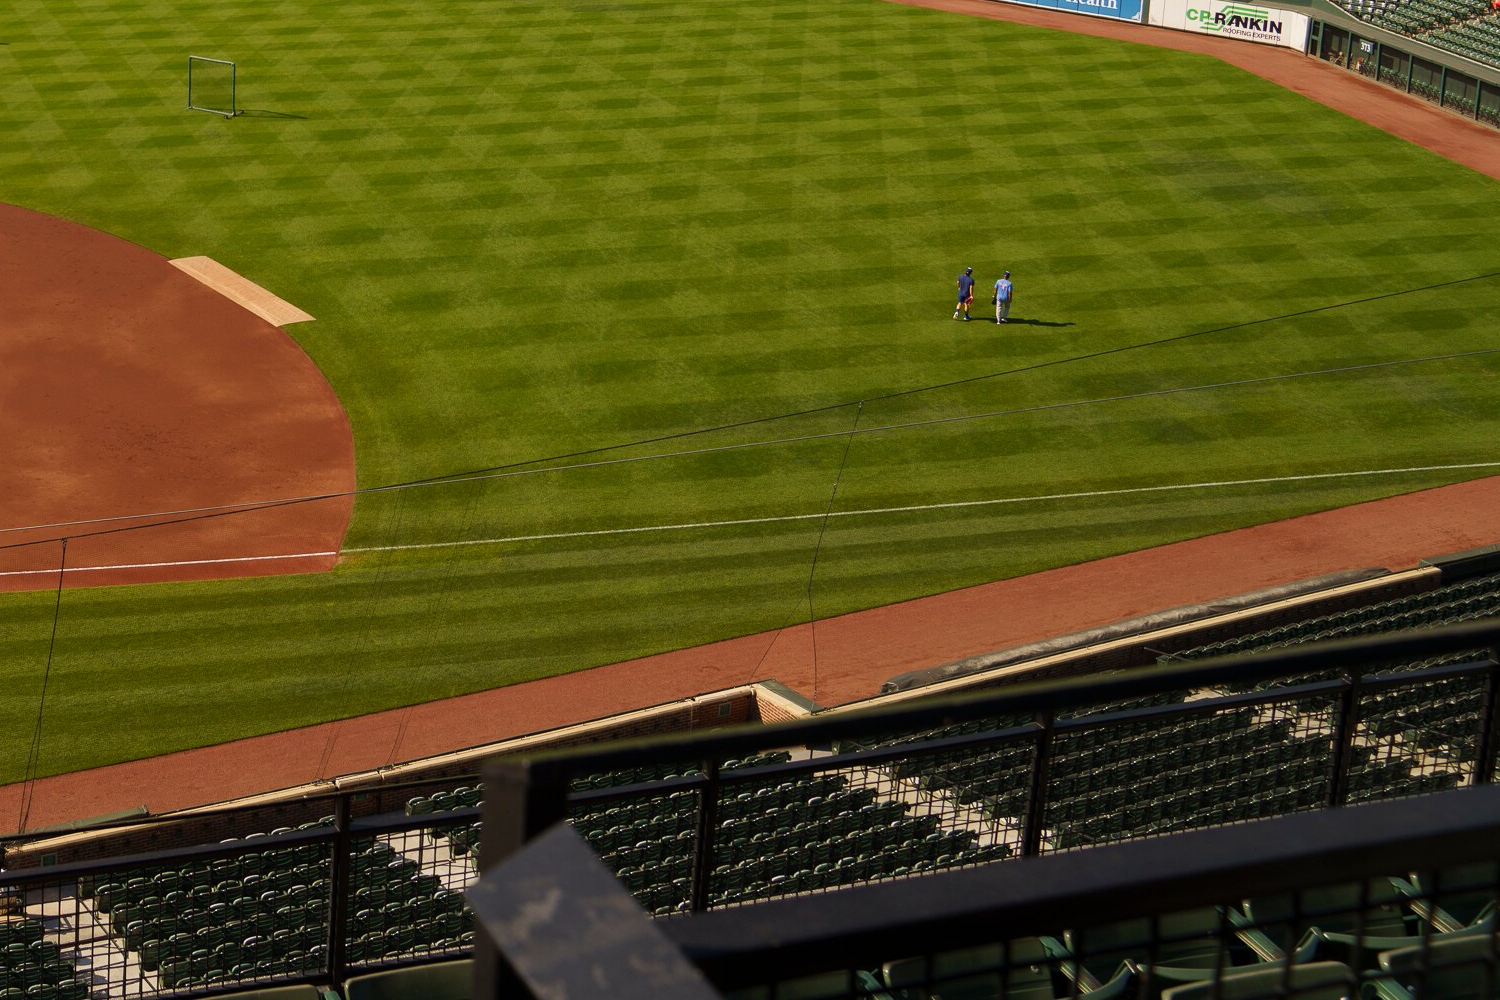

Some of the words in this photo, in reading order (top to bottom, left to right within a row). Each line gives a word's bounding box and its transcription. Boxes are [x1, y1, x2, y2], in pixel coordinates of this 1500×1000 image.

[1222, 27, 1252, 38] ROOFING
[1252, 32, 1282, 42] EXPERTS
[1360, 41, 1371, 53] 373
